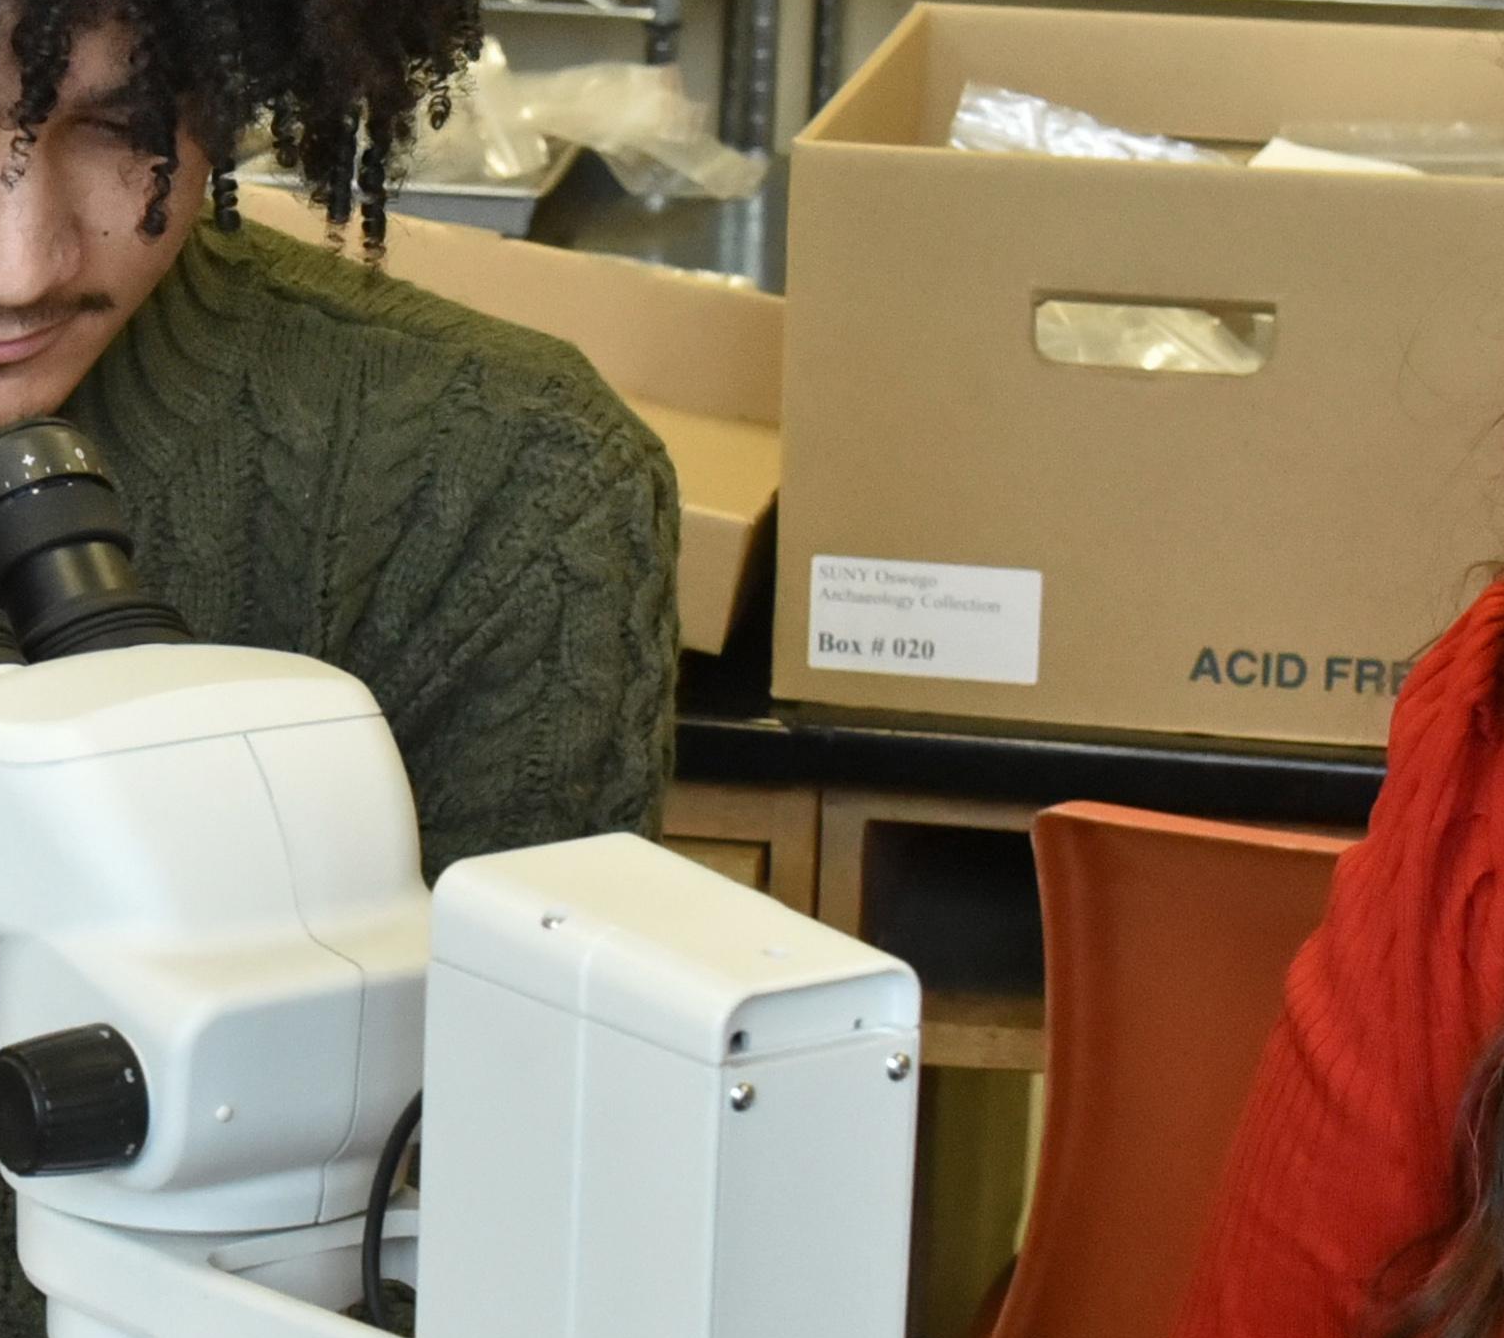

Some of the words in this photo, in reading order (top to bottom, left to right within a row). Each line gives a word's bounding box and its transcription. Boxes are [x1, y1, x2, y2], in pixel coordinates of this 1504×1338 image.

[819, 565, 869, 583] SUNY
[875, 570, 938, 589] Oswego
[819, 587, 915, 610] Archaeology
[920, 593, 1002, 614] Collection
[818, 632, 862, 655] Box
[872, 637, 885, 657] #
[893, 638, 935, 661] 020
[1189, 646, 1308, 690] ACID
